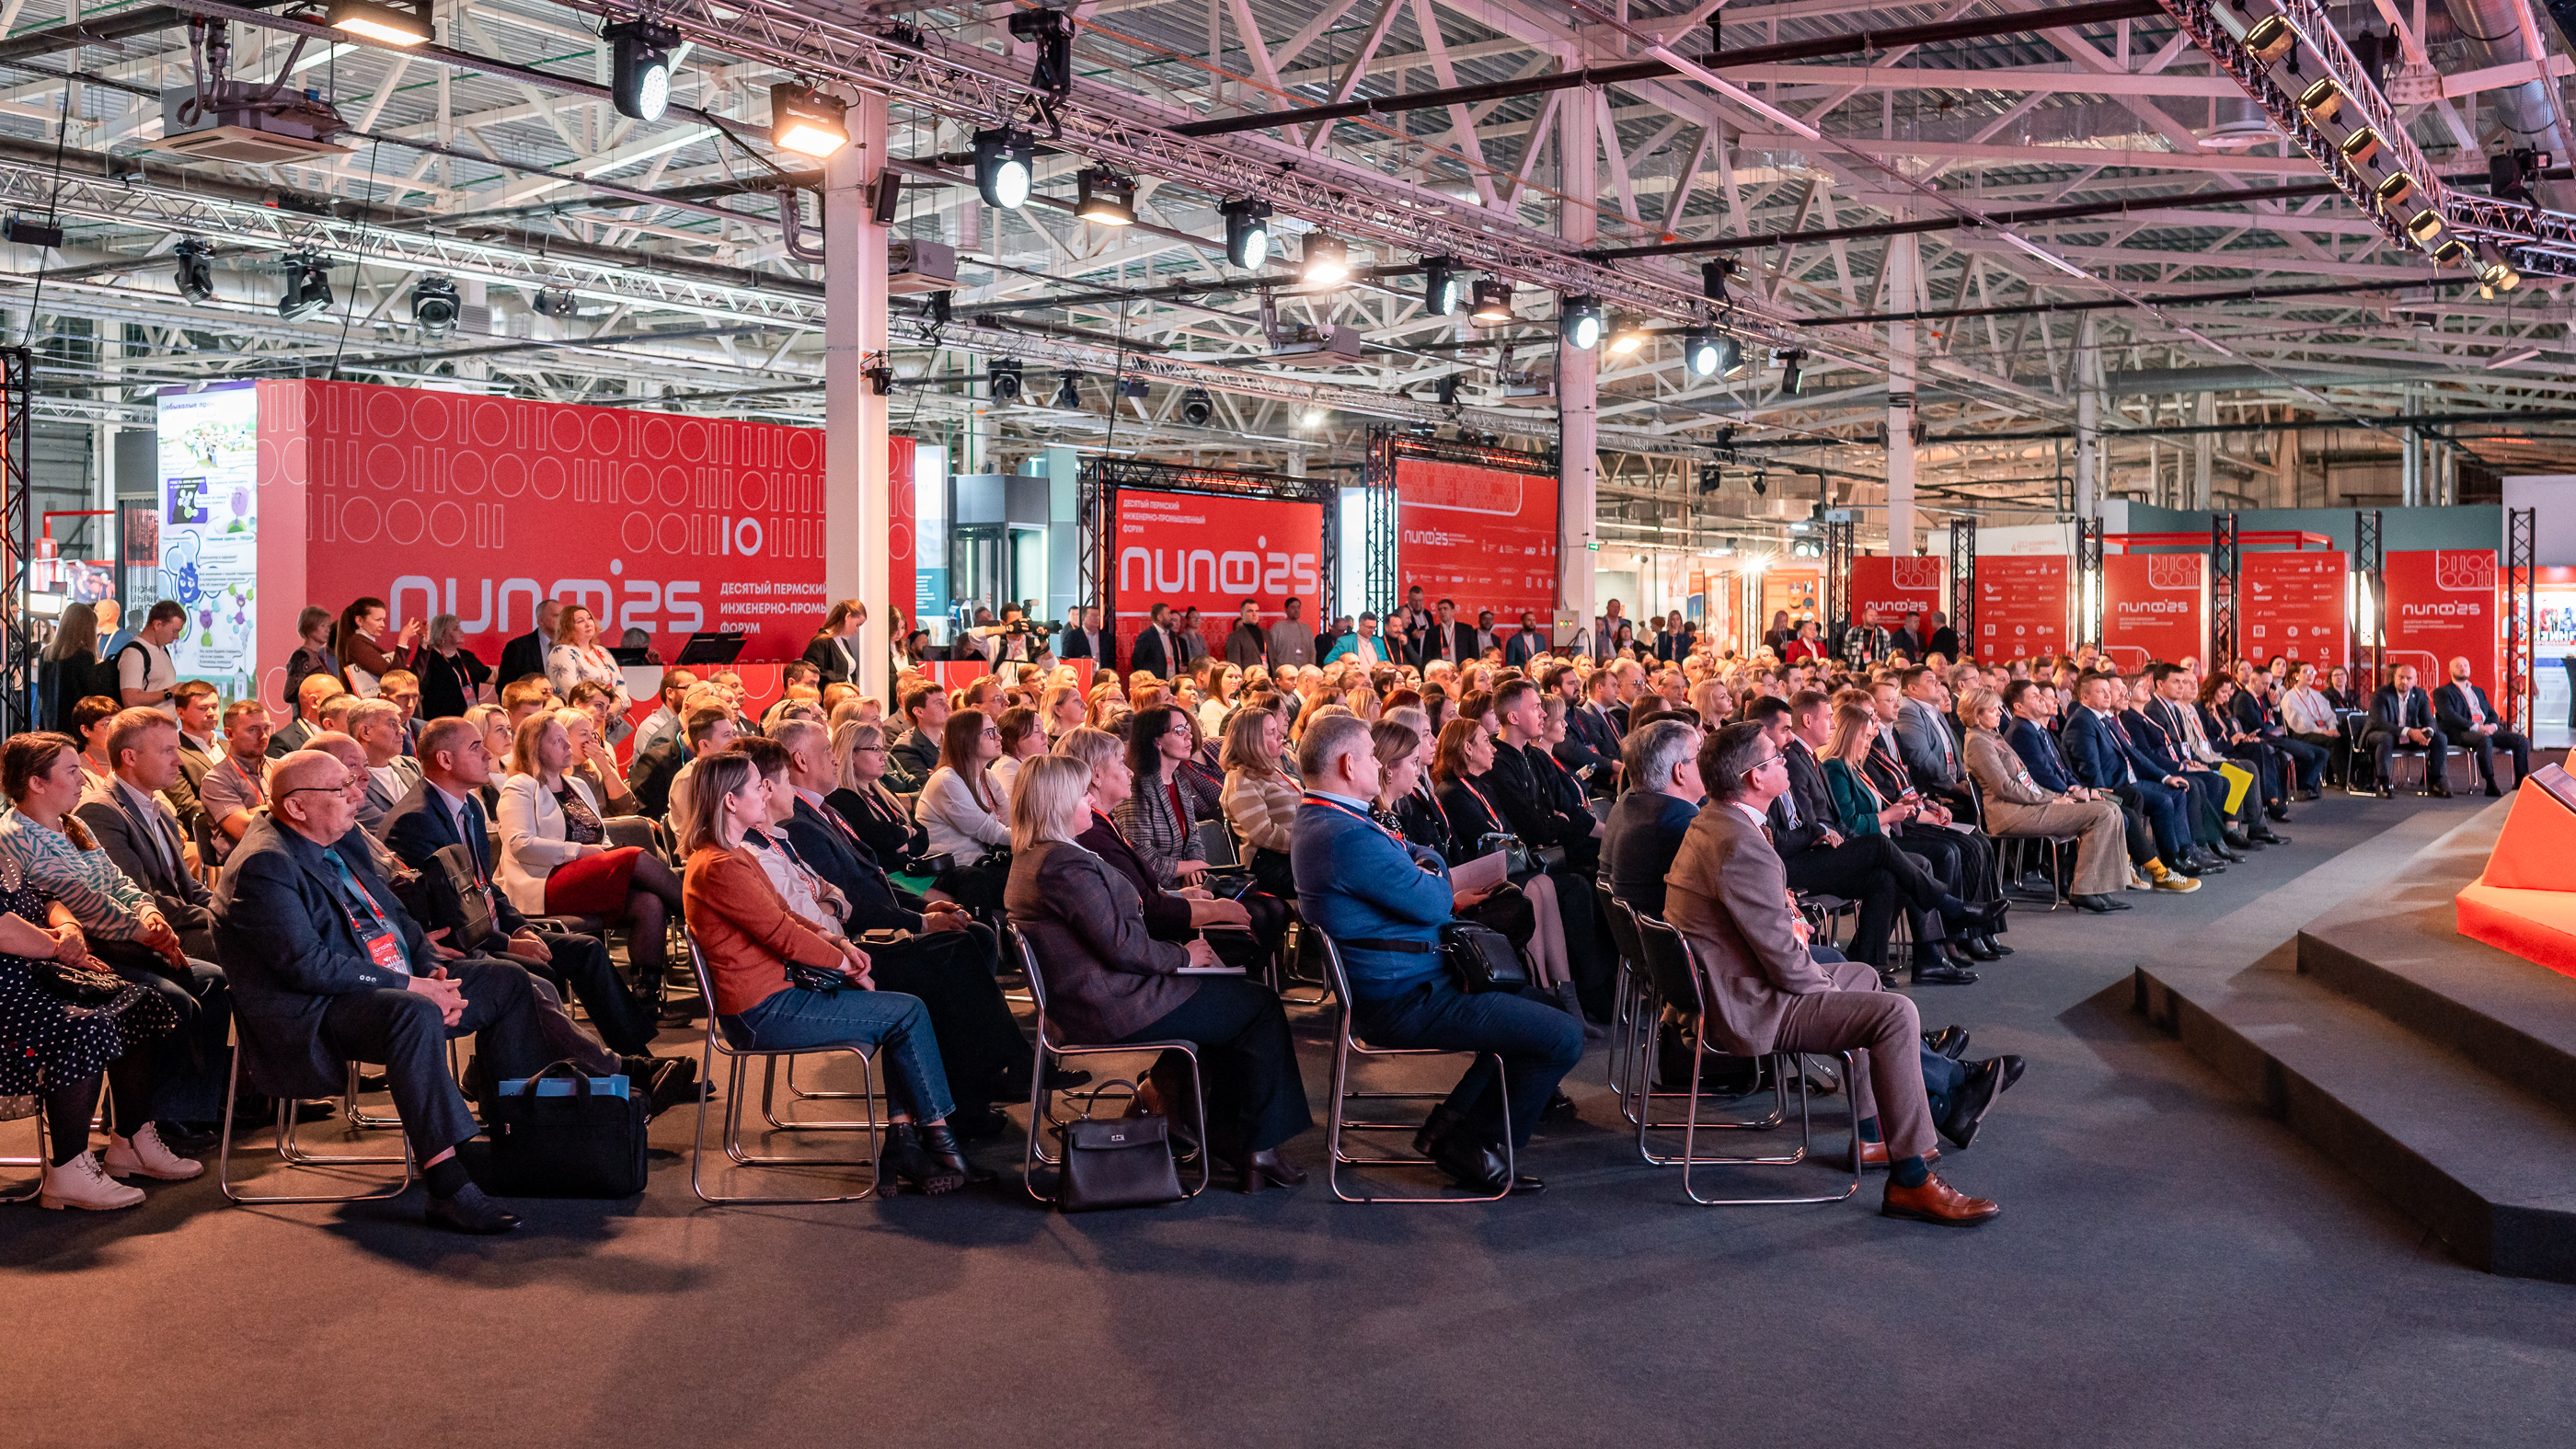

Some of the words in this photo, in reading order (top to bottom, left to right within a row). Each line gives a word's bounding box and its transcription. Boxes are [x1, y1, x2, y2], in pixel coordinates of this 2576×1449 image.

[1122, 523, 1144, 533] ФОРУМ
[720, 581, 771, 596] ДЕСЯТЫЙ
[719, 621, 761, 634] ФОРУМ
